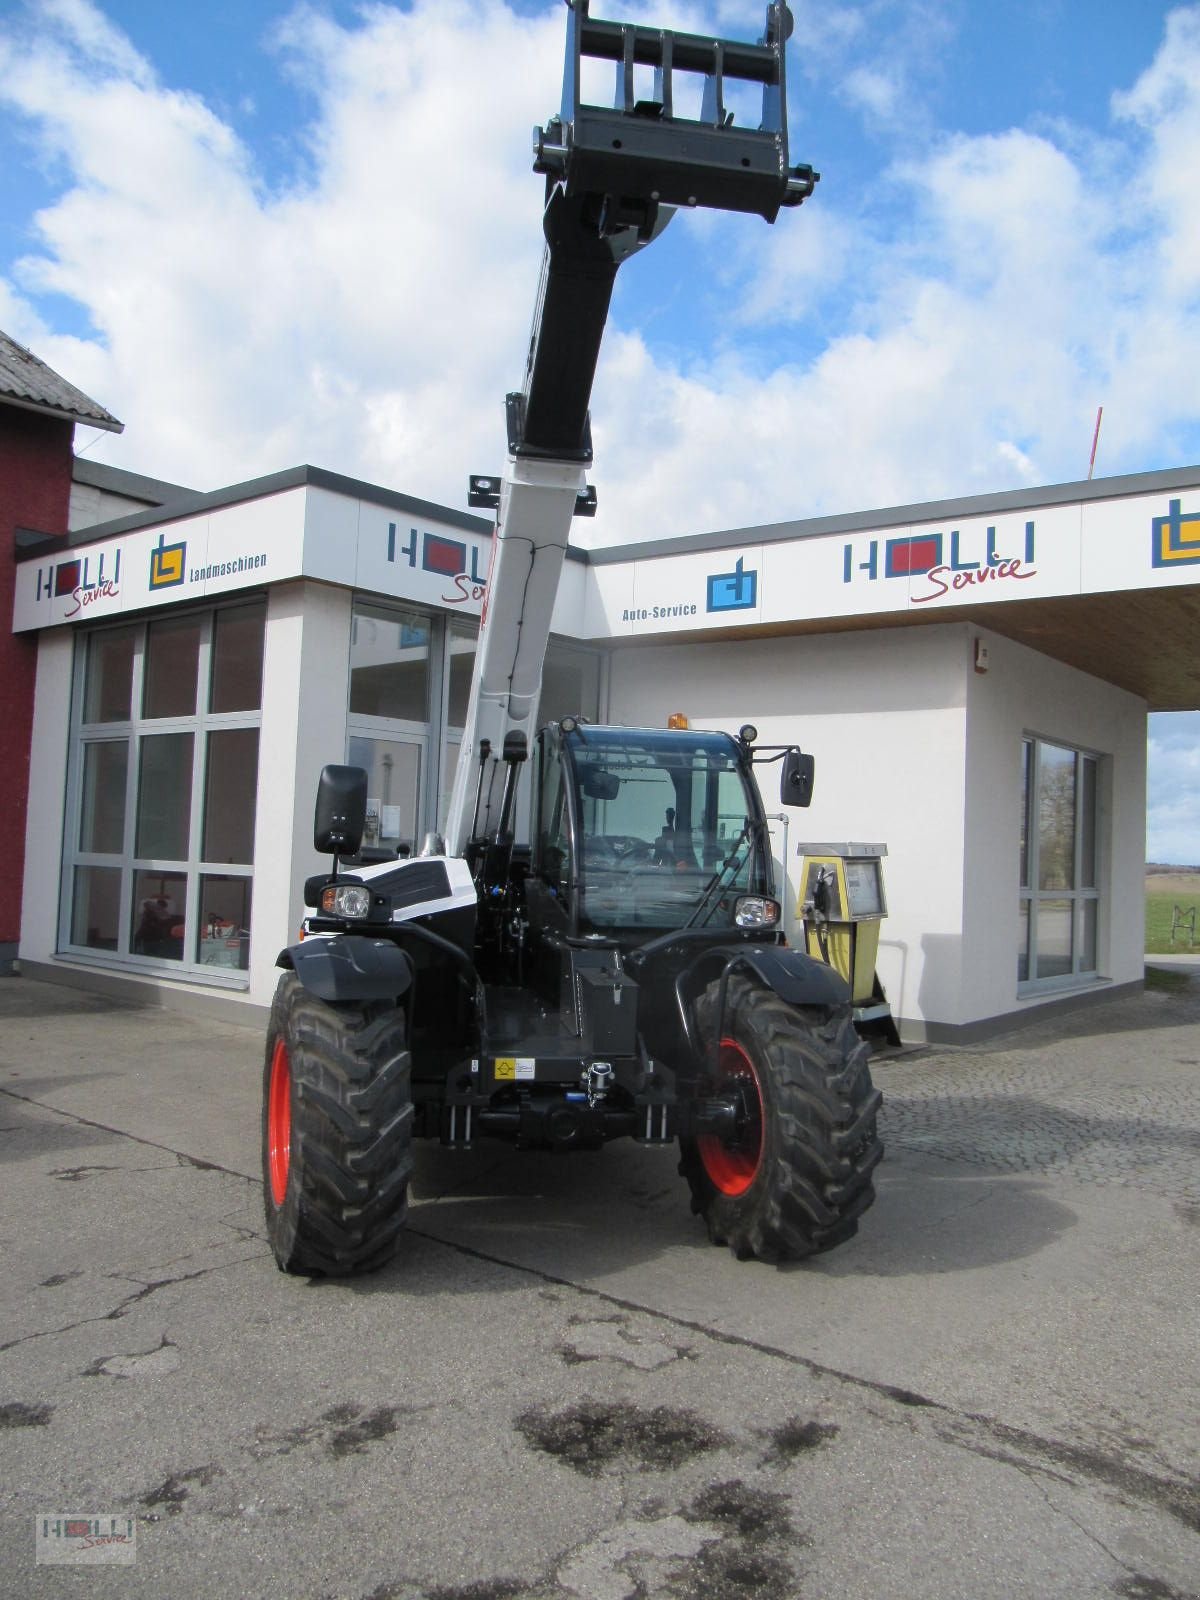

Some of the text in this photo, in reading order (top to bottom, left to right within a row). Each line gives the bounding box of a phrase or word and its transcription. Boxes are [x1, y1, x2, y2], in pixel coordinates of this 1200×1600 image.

[37, 549, 121, 601] HOLLI
[190, 554, 267, 582] Landmaschinen
[387, 522, 487, 585] HOL
[843, 521, 1035, 583] HOLLI
[64, 576, 119, 617] Service
[911, 553, 1036, 602] Service
[622, 604, 697, 621] Auto-Service
